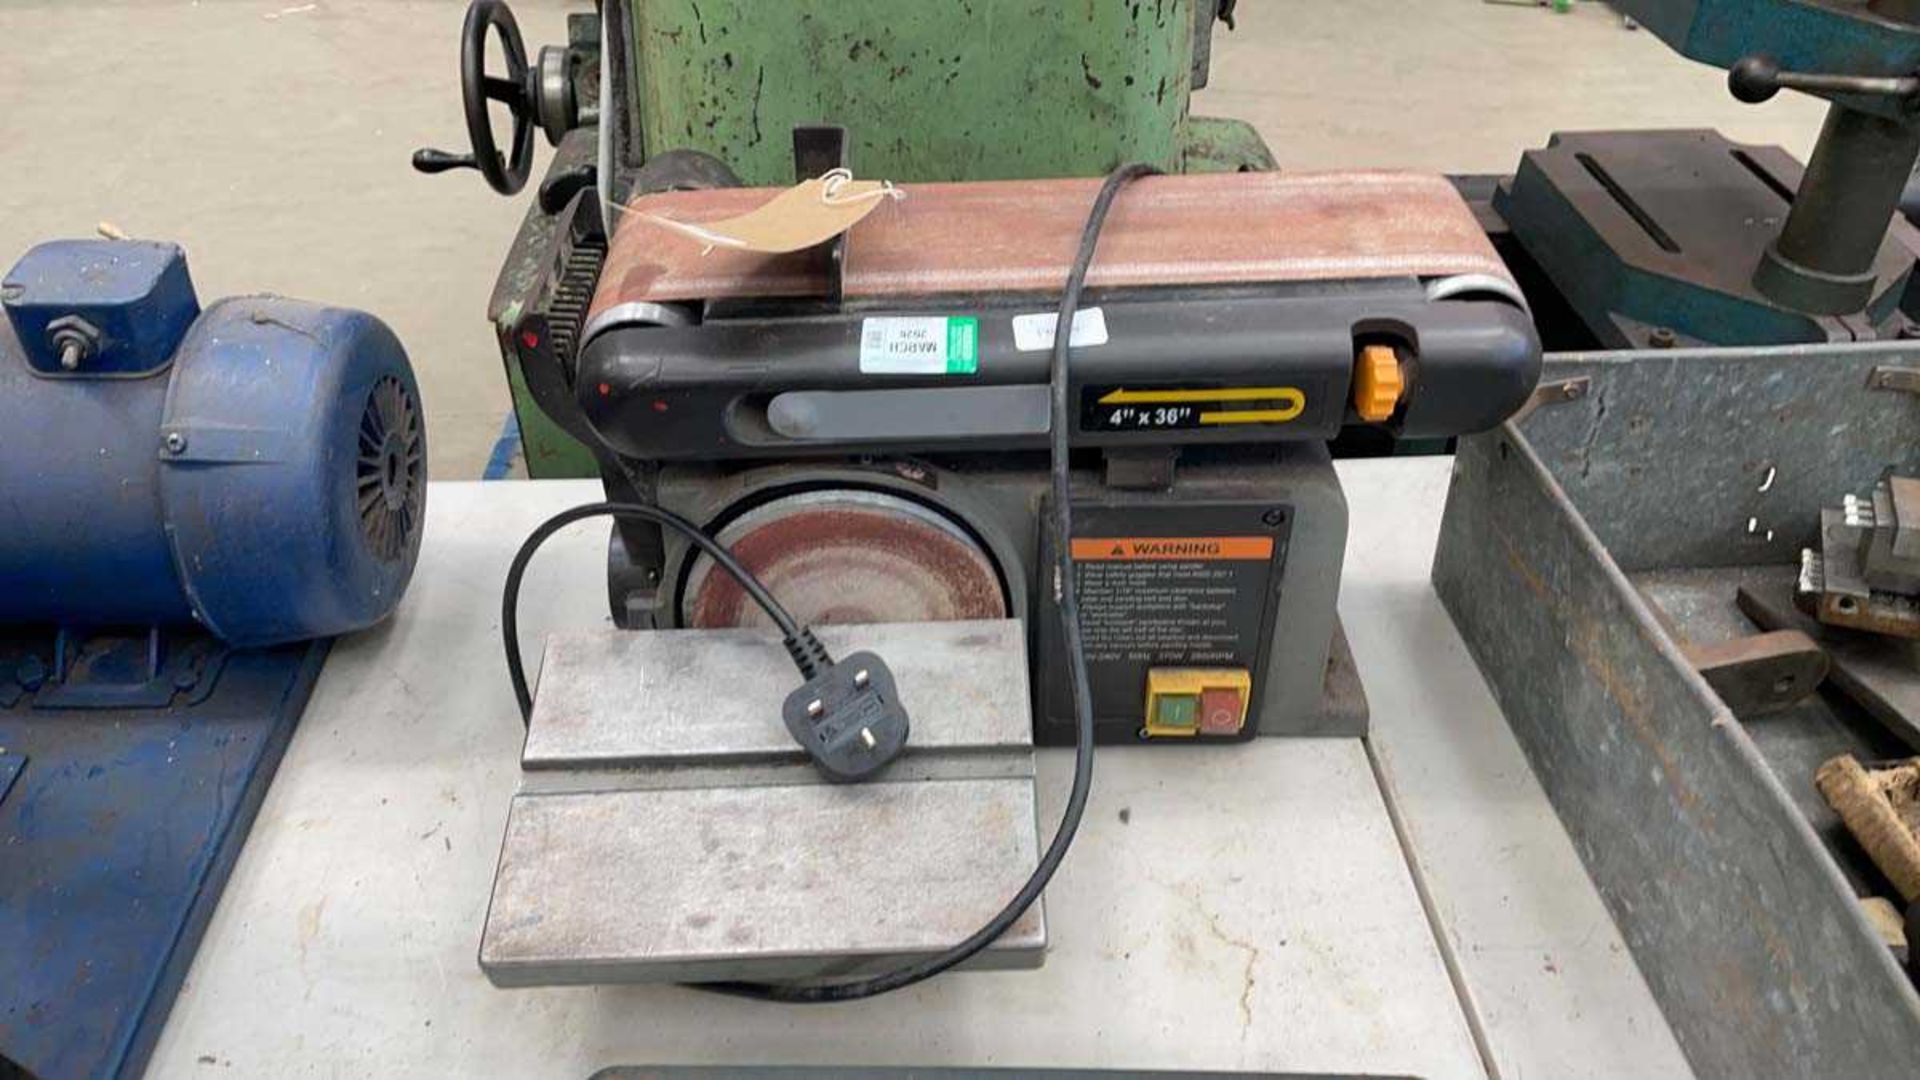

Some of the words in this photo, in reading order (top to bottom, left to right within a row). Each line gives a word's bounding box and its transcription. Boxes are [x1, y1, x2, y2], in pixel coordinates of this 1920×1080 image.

[888, 342, 938, 354] MARCH
[1109, 408, 1135, 425] 4"
[1138, 411, 1150, 425] x
[1155, 407, 1191, 425] 36"
[1132, 542, 1220, 555] WARNING
